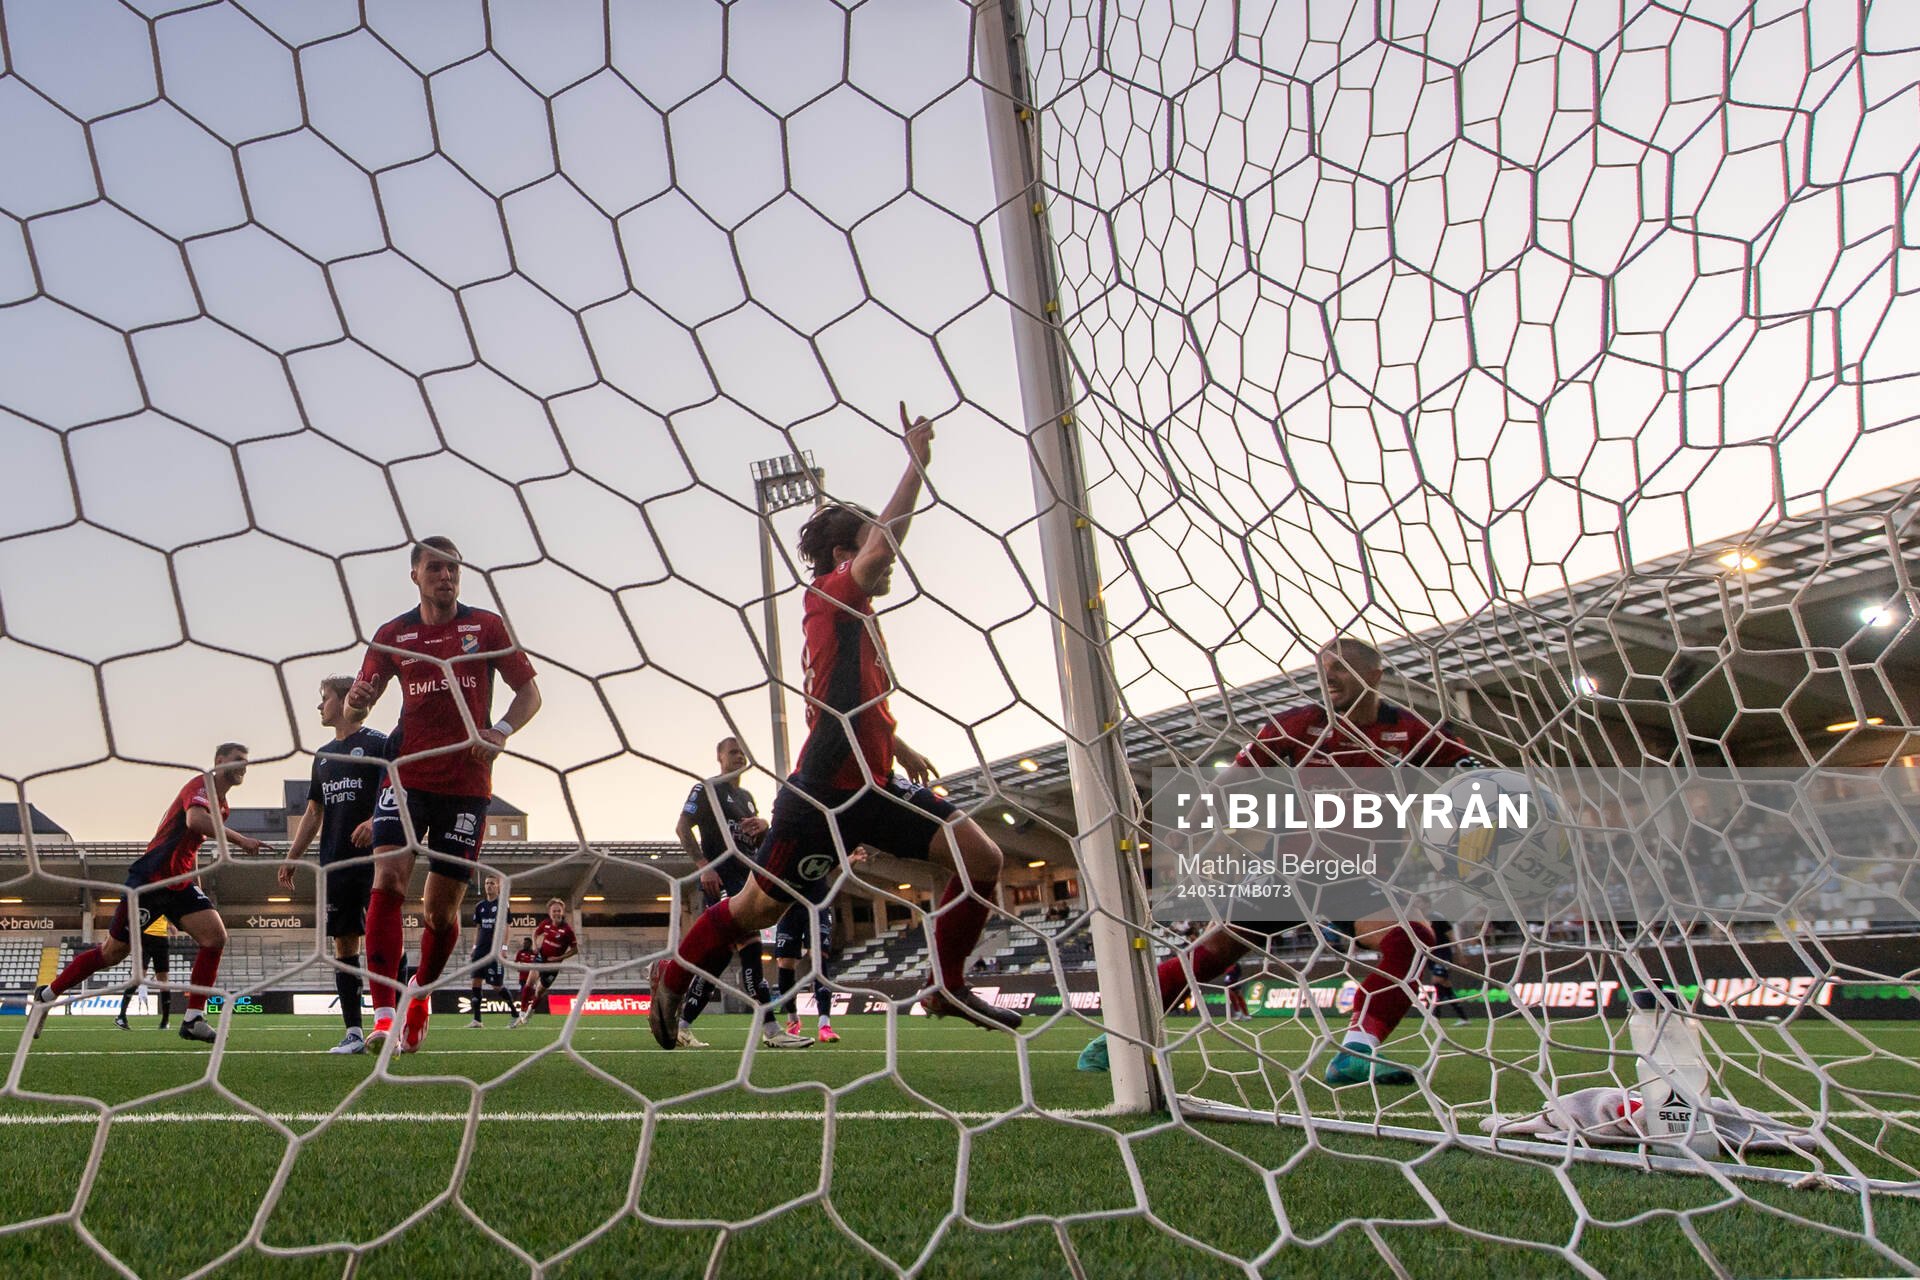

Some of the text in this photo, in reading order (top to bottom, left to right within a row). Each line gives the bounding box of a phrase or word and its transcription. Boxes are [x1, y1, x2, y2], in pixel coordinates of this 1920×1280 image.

[409, 676, 477, 696] EMILSUS
[322, 777, 363, 794] Prioritet
[324, 791, 356, 806] Finans
[11, 917, 54, 929] bravida
[259, 916, 301, 928] bravida
[510, 915, 537, 927] vida
[1514, 981, 1619, 1007] UNIBET
[1701, 977, 1842, 1007] UNIBET
[480, 998, 521, 1012] Envio
[995, 993, 1036, 1009] UNIBET
[1659, 1111, 1699, 1122] SELEC
